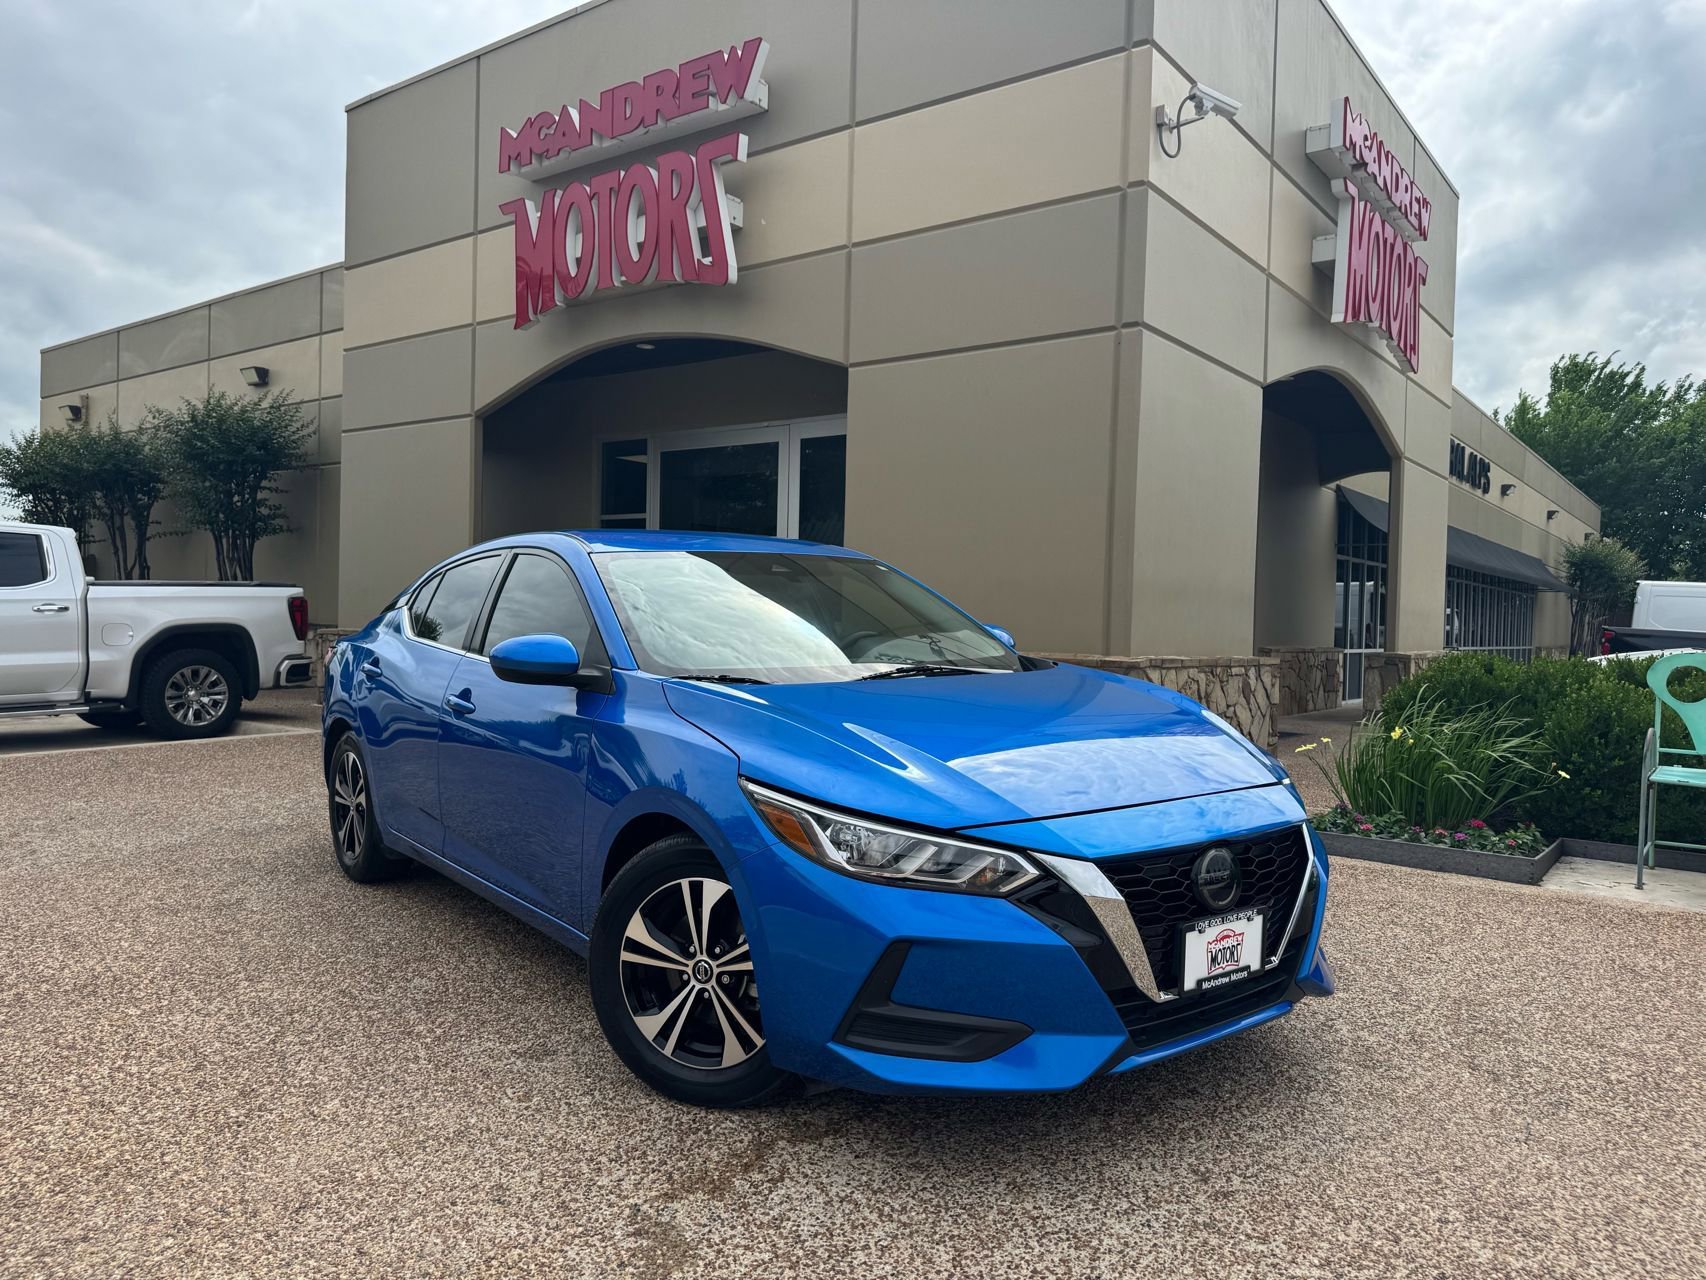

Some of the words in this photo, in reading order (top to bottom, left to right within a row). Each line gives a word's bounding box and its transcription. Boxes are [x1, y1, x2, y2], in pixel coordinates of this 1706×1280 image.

[499, 132, 739, 330] MOTORS
[1344, 177, 1428, 374] MOTORS
[1195, 921, 1210, 930] LOVE
[1223, 914, 1238, 923] LOVE
[1237, 909, 1257, 920] PEOPLE
[1208, 943, 1241, 970] MOTORS
[1202, 977, 1230, 989] McAndrew
[1230, 970, 1248, 981] Motors
